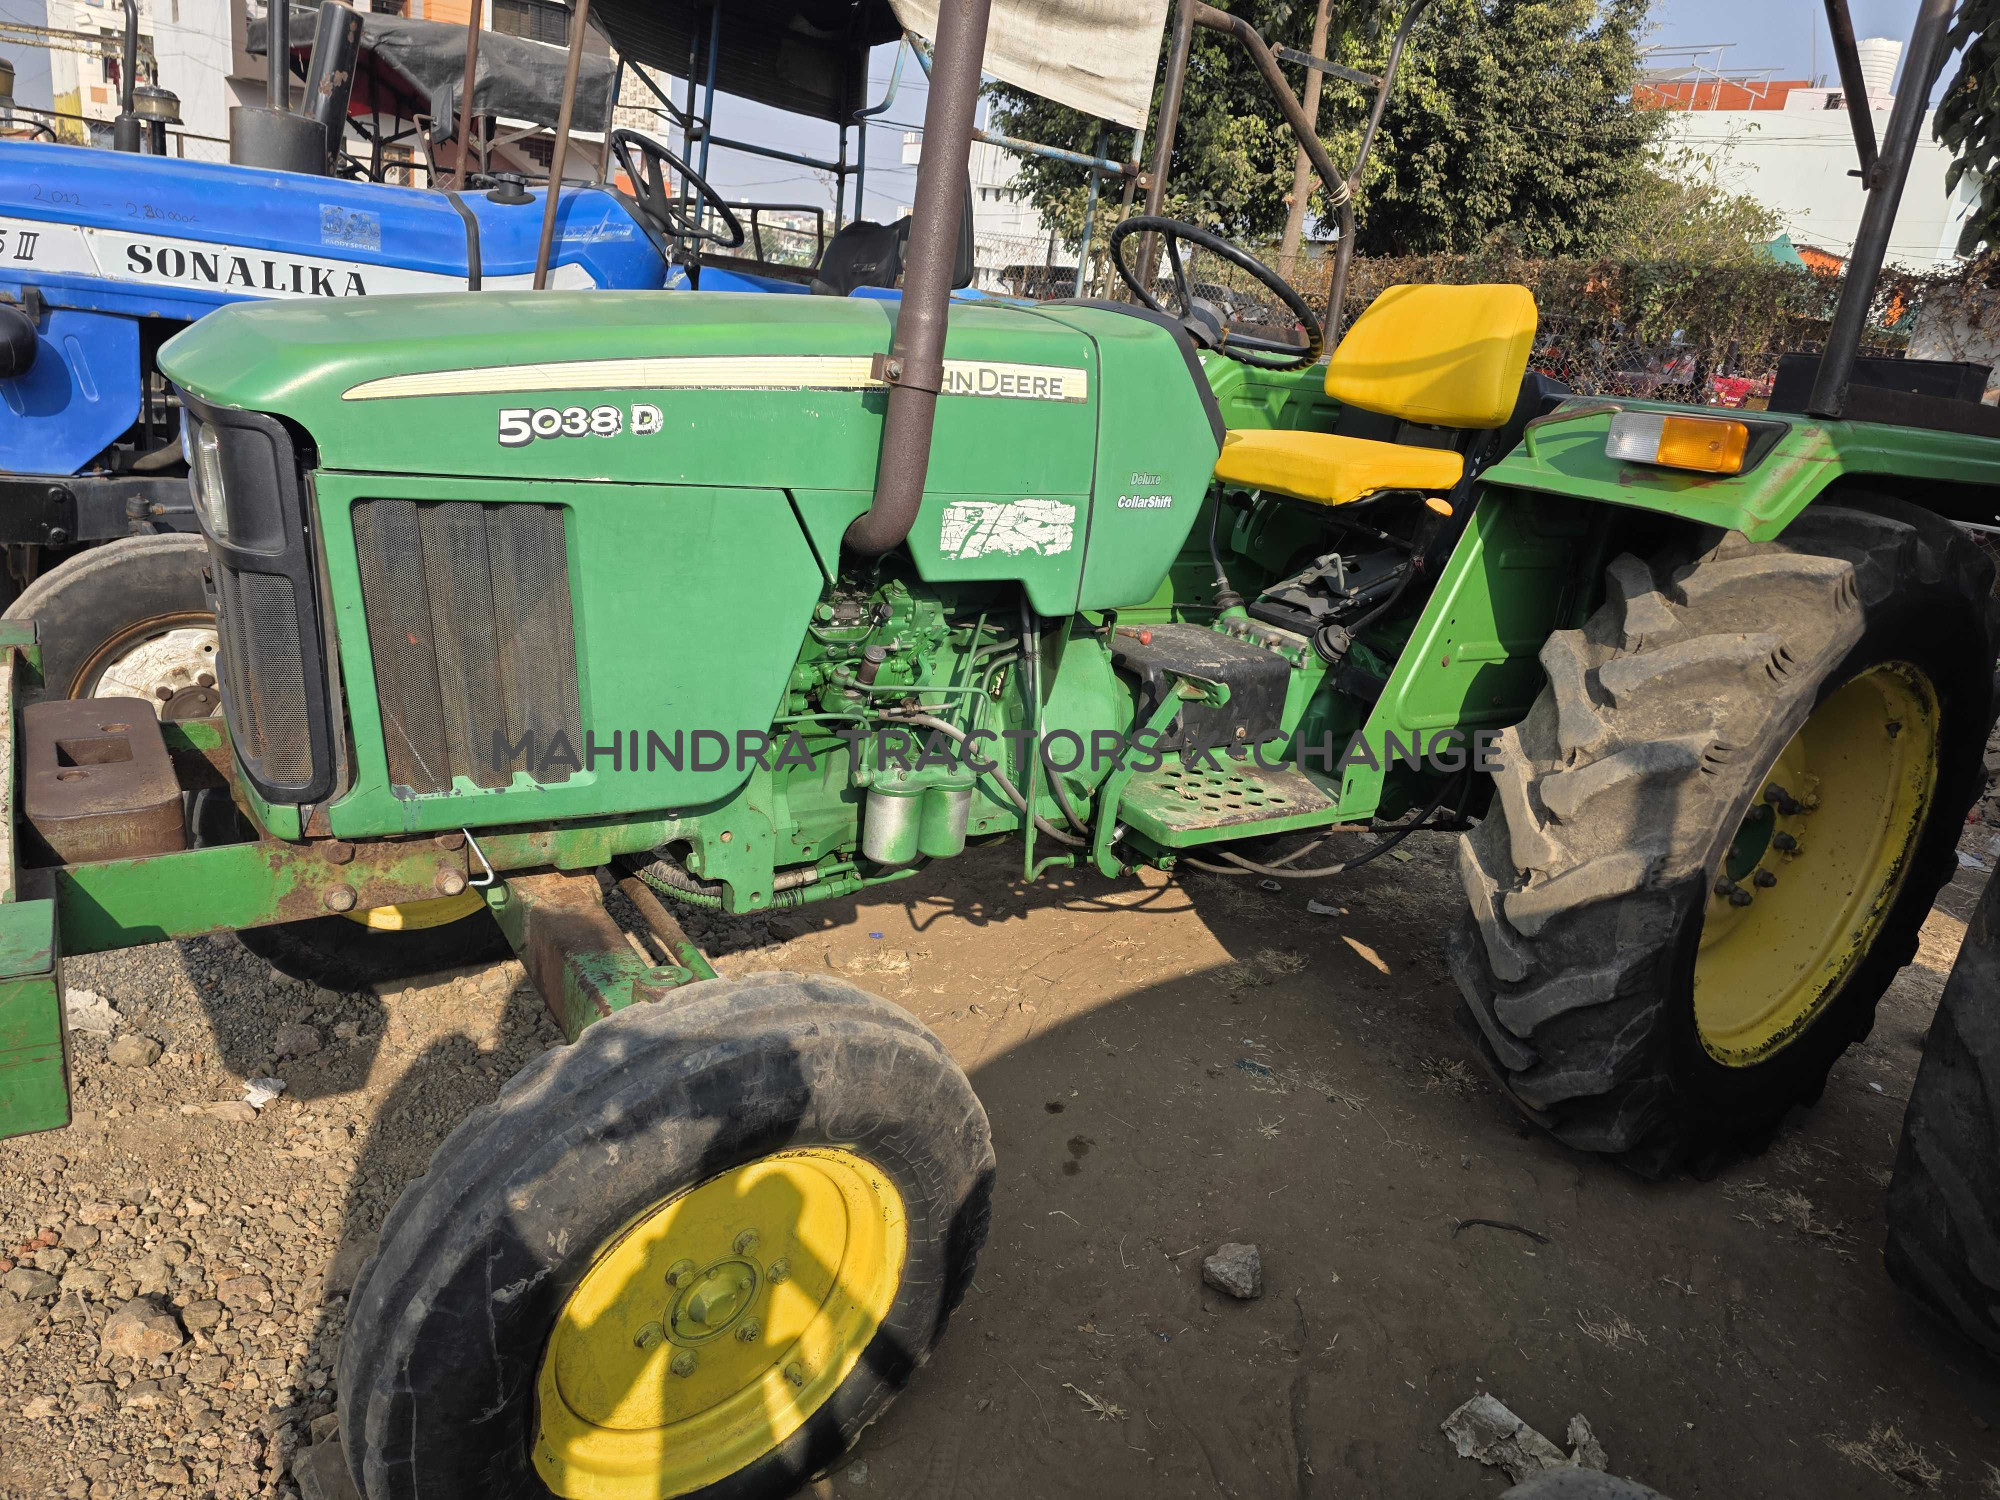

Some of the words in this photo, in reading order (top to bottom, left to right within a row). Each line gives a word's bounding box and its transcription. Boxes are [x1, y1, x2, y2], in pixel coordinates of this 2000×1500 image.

[28, 183, 88, 208] 2012
[325, 239, 349, 249] PADDY
[350, 242, 380, 252] SPECIAL
[126, 244, 367, 298] SONALIKA
[978, 368, 1063, 396] DEERE
[498, 404, 624, 449] 5038
[630, 403, 664, 436] D
[1129, 471, 1161, 486] Deluxe
[1117, 494, 1172, 509] CollarShift
